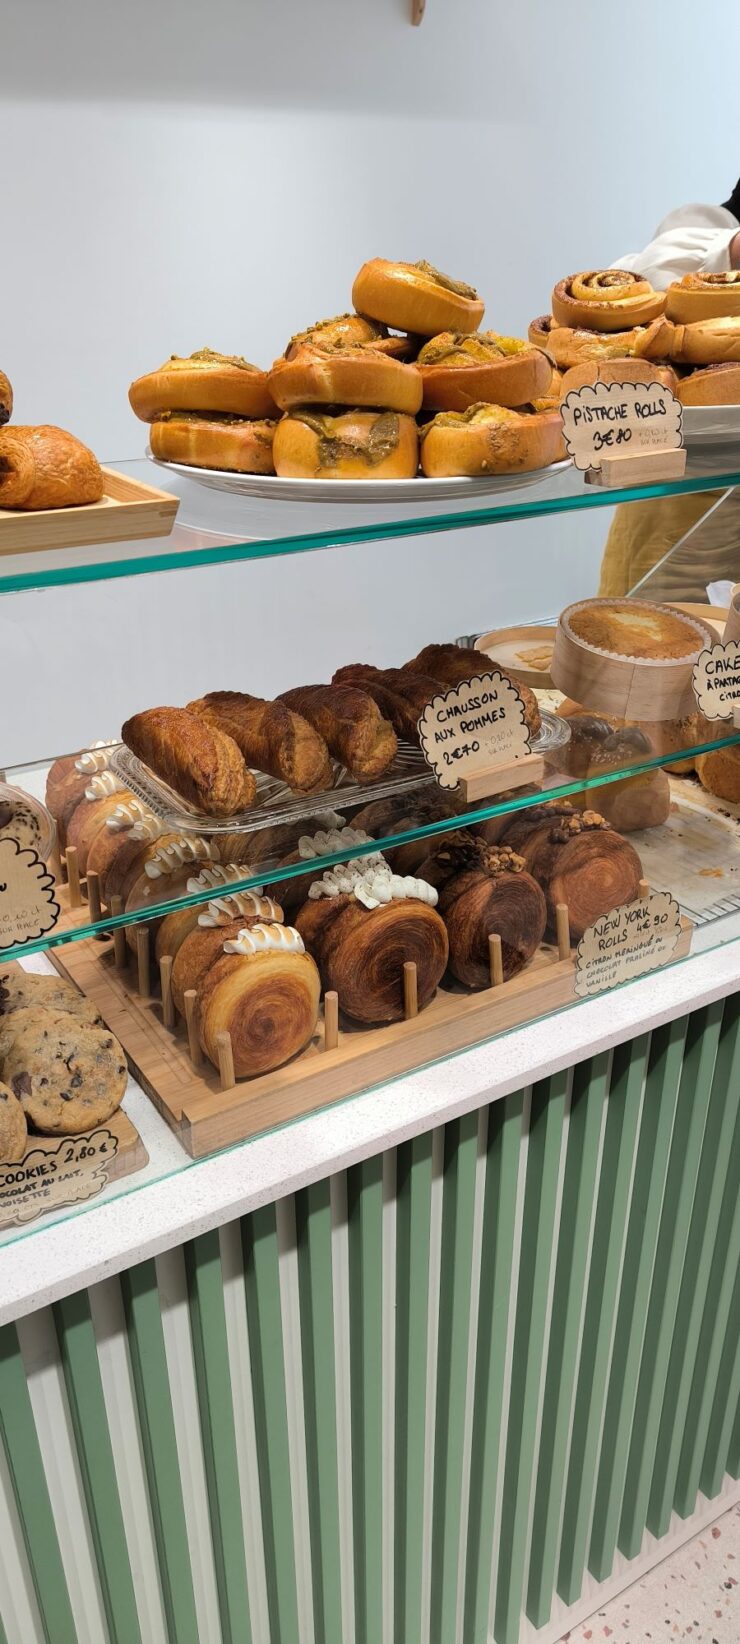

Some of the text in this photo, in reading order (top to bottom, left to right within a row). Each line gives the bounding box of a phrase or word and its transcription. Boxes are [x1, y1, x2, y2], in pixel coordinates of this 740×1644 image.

[634, 399, 667, 419] ROLLS
[705, 655, 740, 674] CAKE
[437, 690, 498, 722] CHAUSSON
[434, 707, 506, 743] AUX POMMES
[593, 914, 621, 938] NEW
[625, 906, 651, 926] YORK
[598, 929, 628, 951] ROLLS
[63, 1146, 96, 1164] 2,80
[41, 1177, 55, 1188] AU
